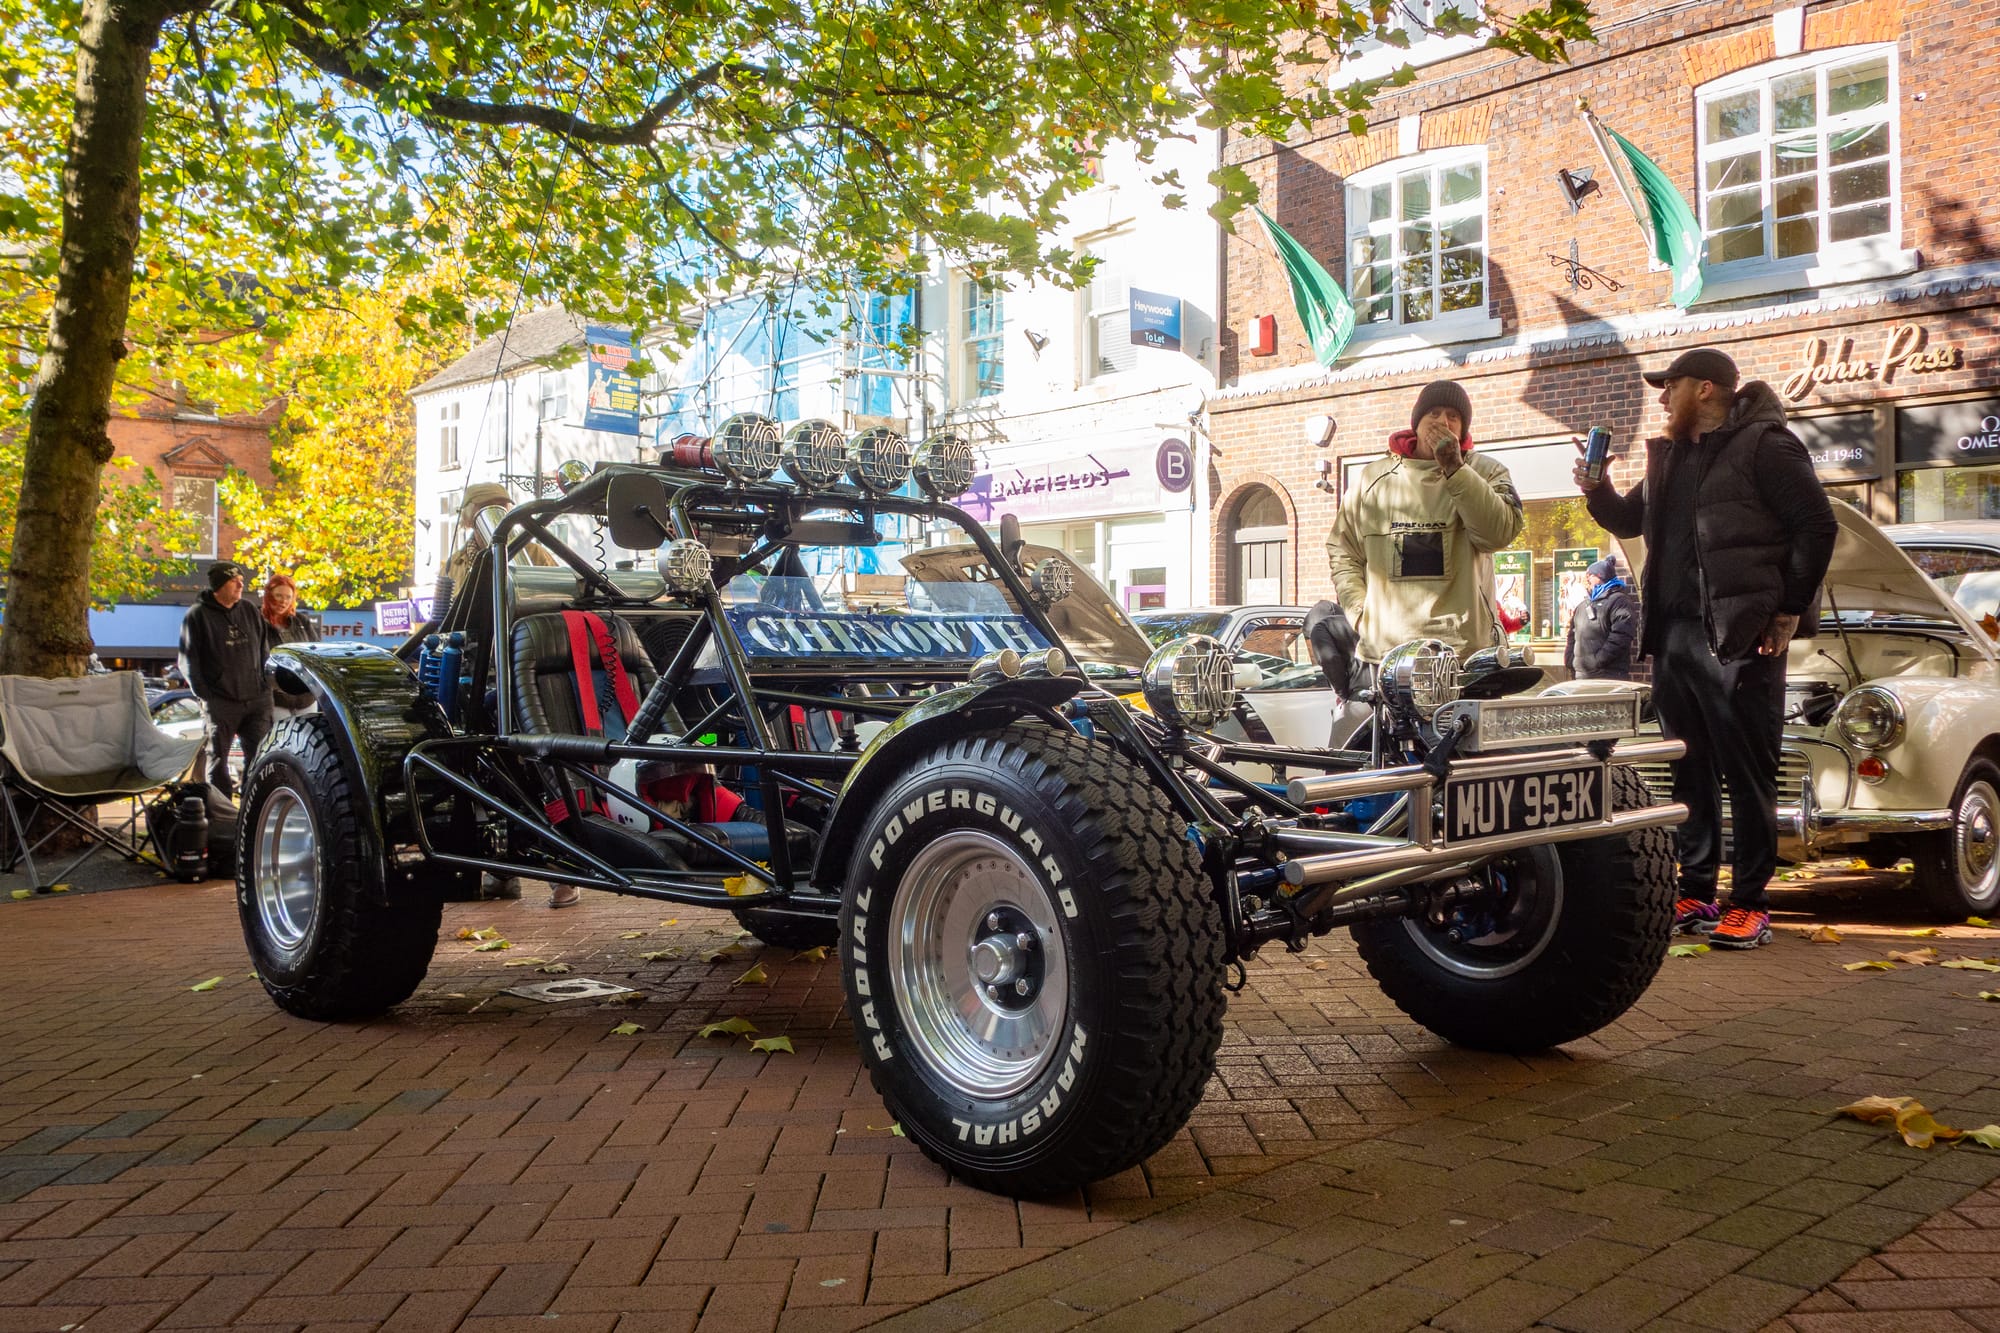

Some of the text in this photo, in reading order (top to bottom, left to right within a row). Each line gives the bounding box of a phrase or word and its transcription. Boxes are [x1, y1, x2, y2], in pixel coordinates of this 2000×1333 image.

[1134, 300, 1173, 317] Heywoods
[1144, 331, 1165, 343] To Let
[1782, 322, 1956, 400] John Pass
[1957, 434, 2000, 450] OME
[1167, 451, 1185, 479] B
[1834, 447, 1862, 461] 1948
[383, 607, 408, 617] METRO
[383, 616, 409, 626] SHOPS
[747, 615, 1042, 653] CHENOWTH
[1457, 770, 1596, 837] MUY 953K
[854, 788, 1079, 1062] RADIAL POWERGUARD
[951, 1021, 1088, 1145] MARSHAL
